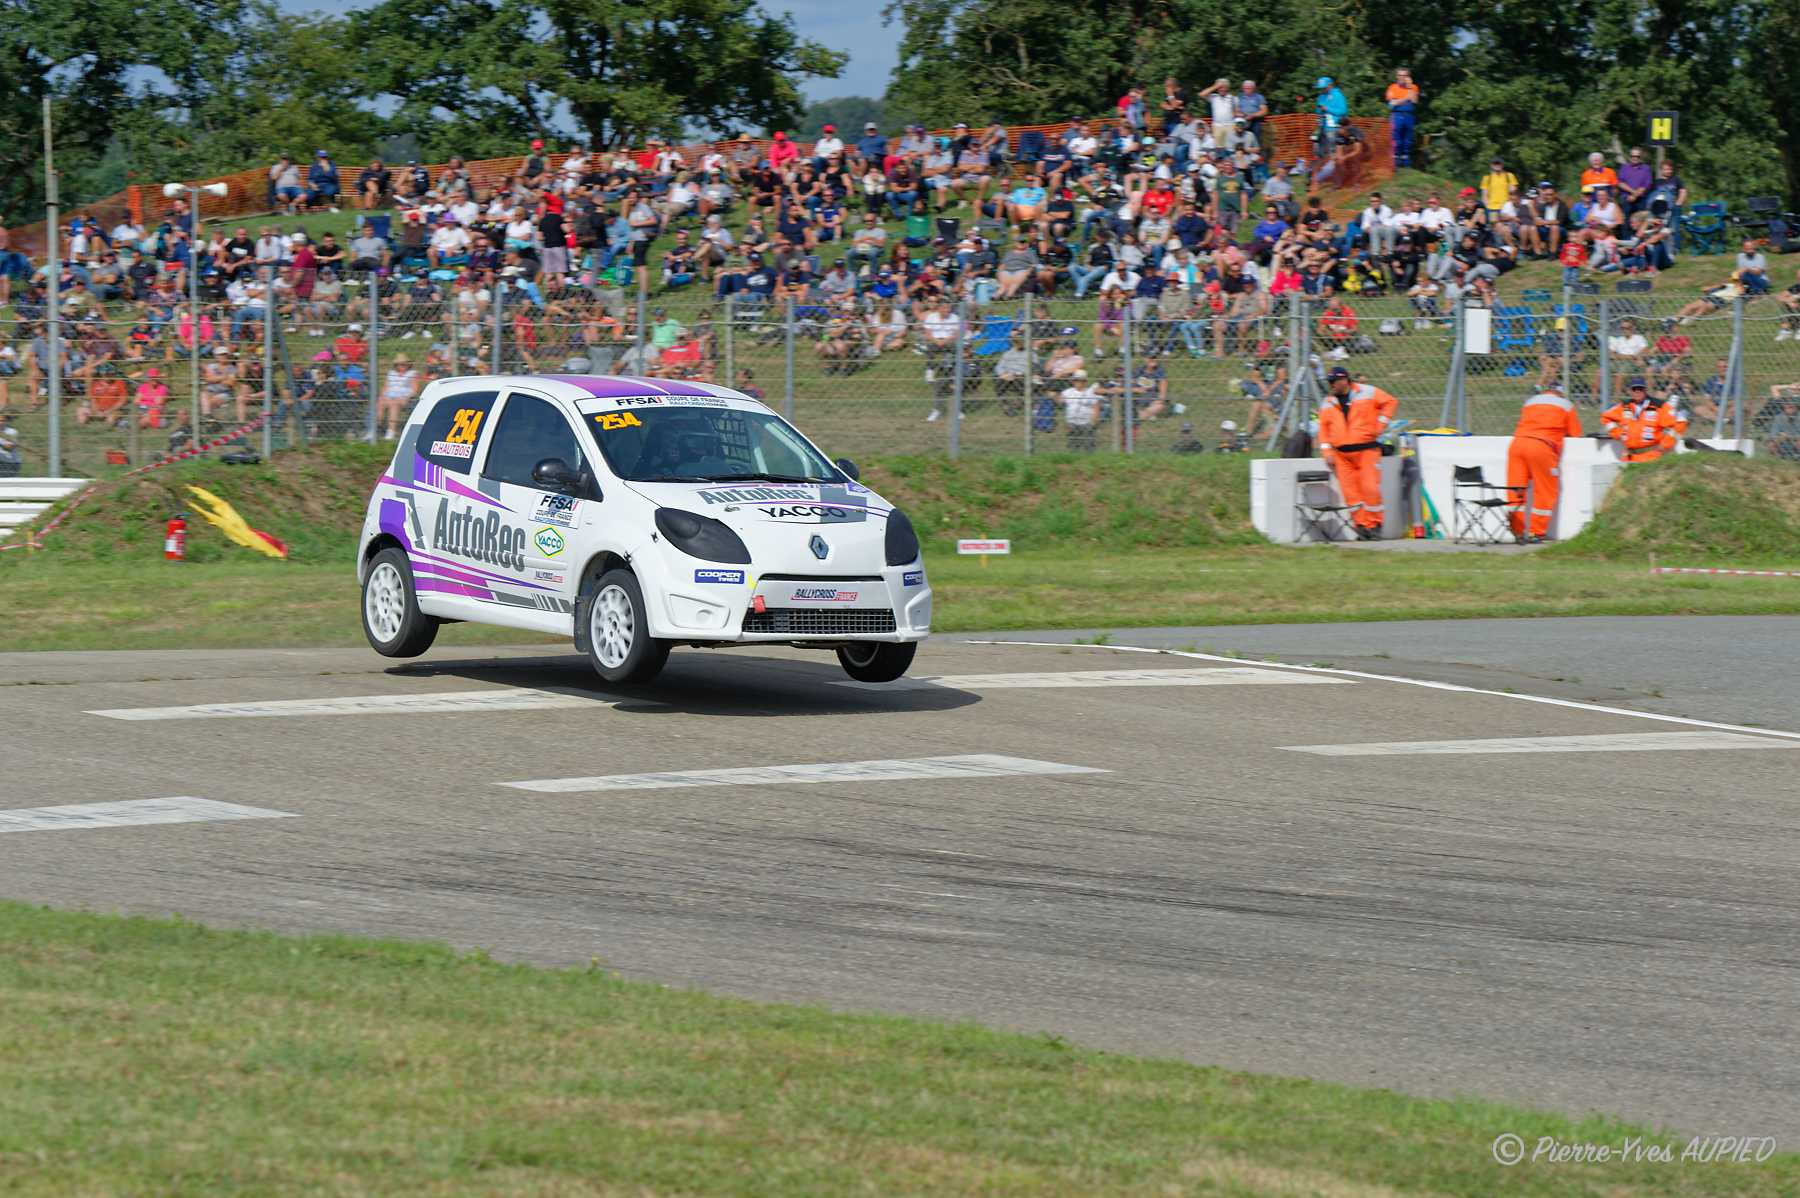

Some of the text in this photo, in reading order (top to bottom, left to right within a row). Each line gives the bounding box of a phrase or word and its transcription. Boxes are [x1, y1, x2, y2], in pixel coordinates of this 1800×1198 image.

[1651, 118, 1672, 140] H
[616, 396, 657, 406] FFSA
[446, 408, 484, 446] 254
[594, 412, 642, 430] 254
[540, 494, 573, 511] FFSA
[697, 487, 815, 505] AutoRec
[757, 505, 847, 518] YACCO
[433, 497, 526, 573] AutoRec
[537, 534, 562, 549] YACCO
[698, 571, 741, 579] COOPER
[794, 588, 837, 599] RALLYCROSS
